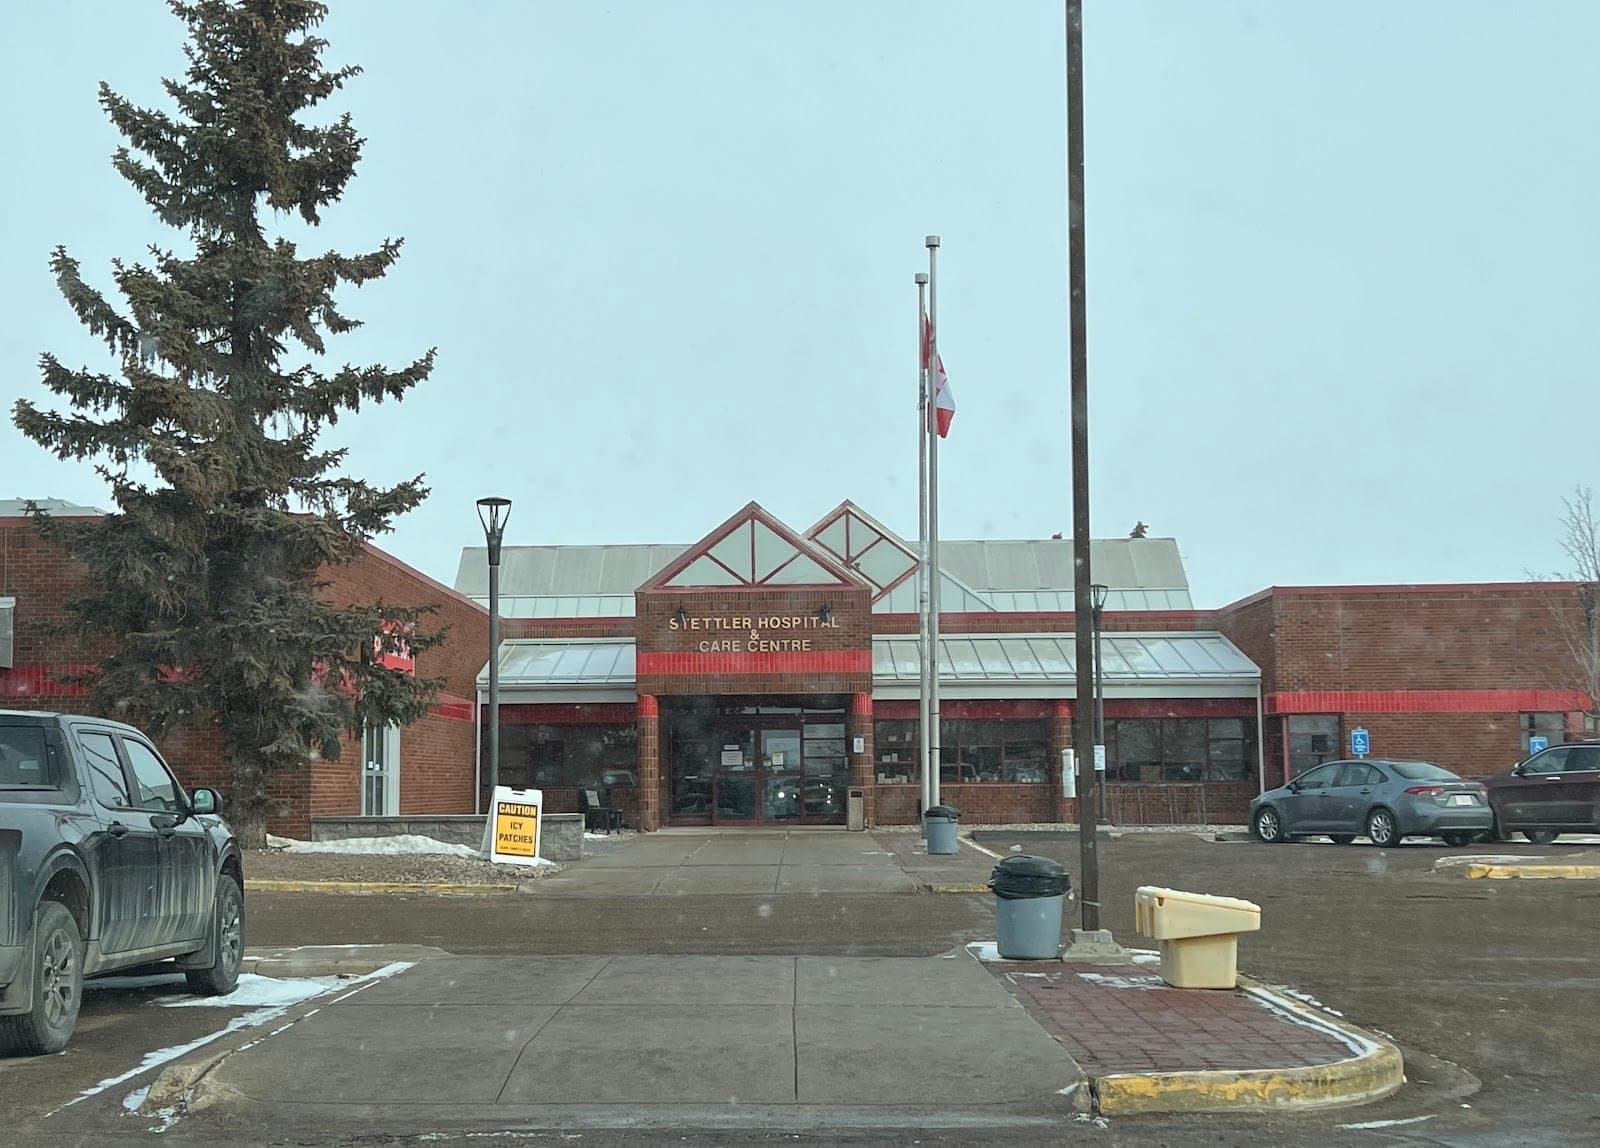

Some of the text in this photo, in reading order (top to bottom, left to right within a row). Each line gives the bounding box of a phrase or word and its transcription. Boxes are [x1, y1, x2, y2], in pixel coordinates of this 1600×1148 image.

[750, 629, 760, 640] &
[699, 639, 811, 653] CARE CENTRE
[499, 803, 537, 816] CAUTION
[510, 821, 524, 830] ICY
[499, 832, 533, 844] PATCHES
